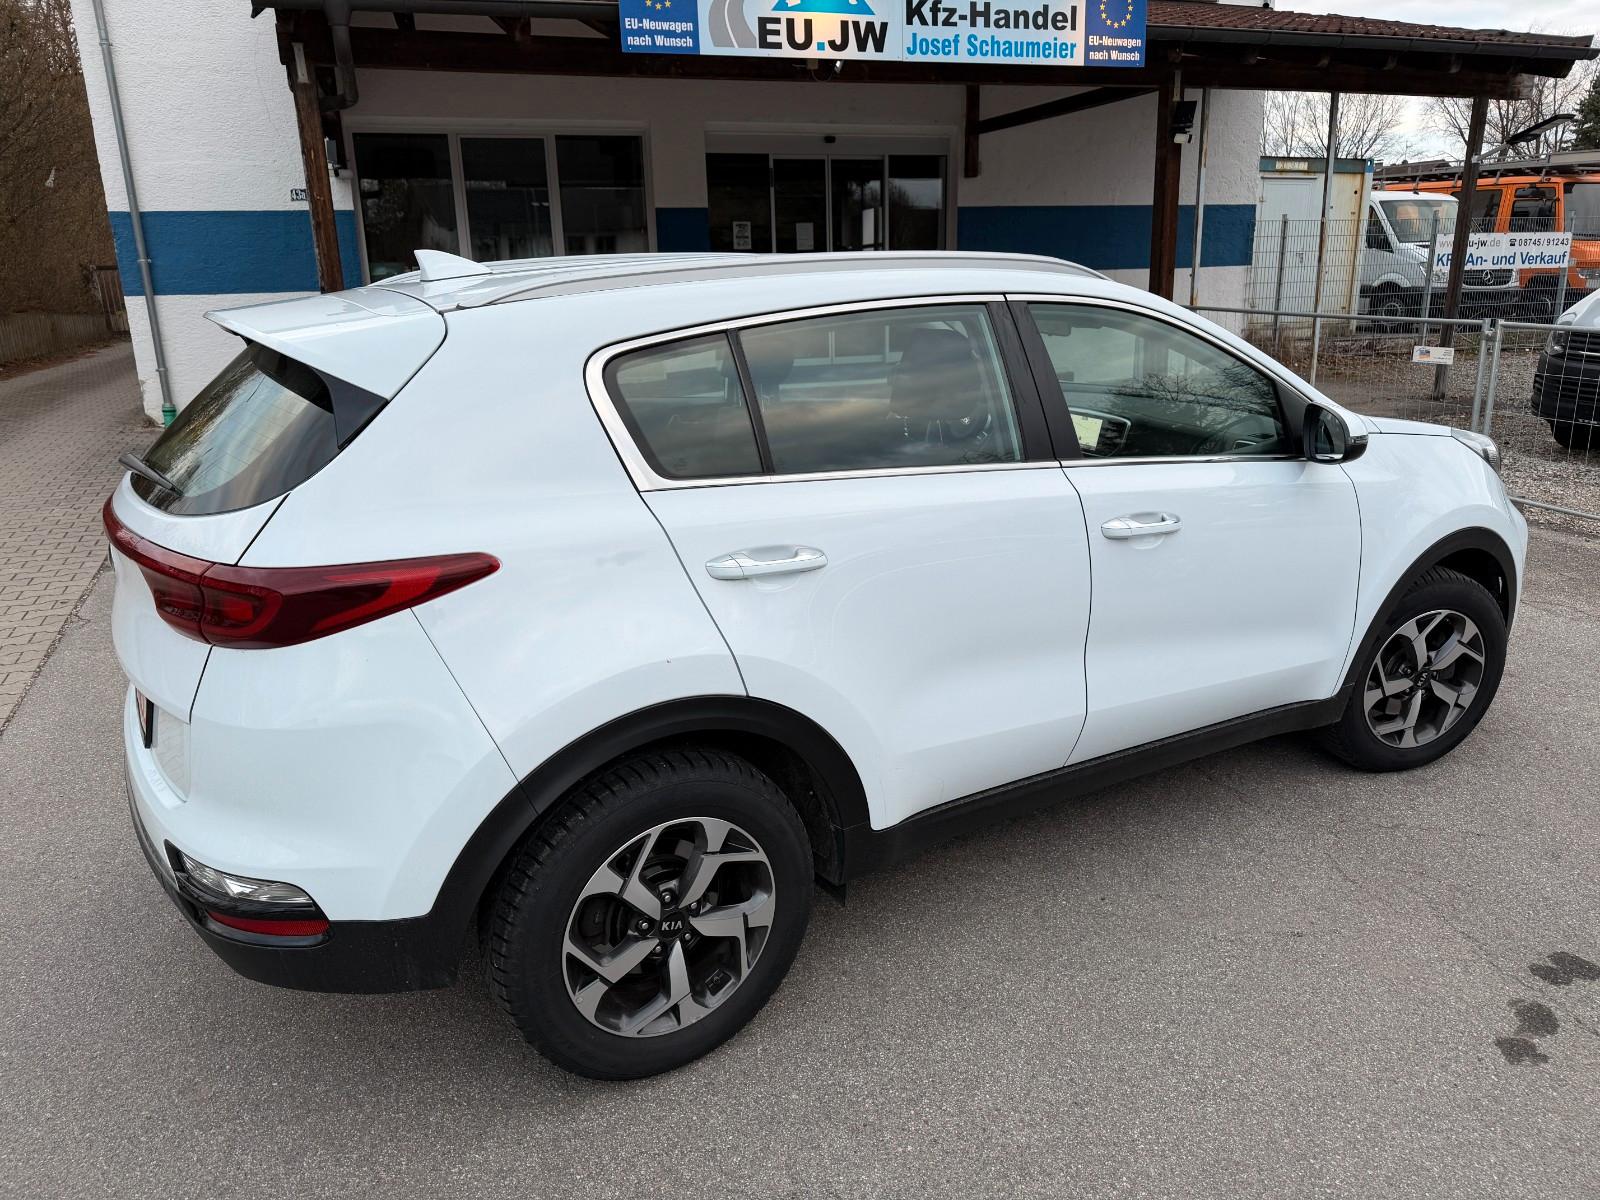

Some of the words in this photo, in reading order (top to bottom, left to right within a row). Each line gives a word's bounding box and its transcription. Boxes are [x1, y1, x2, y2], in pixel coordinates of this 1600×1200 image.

[905, 0, 1077, 31] Kfz-Handel
[624, 17, 693, 32] EU-Neuwagen
[627, 34, 651, 46] nach
[654, 35, 693, 47] Wunsch
[757, 16, 889, 53] EU.JW
[1088, 35, 1142, 49] EU-Neuwagen
[906, 32, 960, 56] Josef
[966, 33, 1077, 59] Schaumeier
[1089, 50, 1108, 60] nach
[1110, 50, 1140, 61] Wunsch
[1491, 252, 1517, 266] und
[1520, 250, 1568, 265] Verkauf
[661, 920, 683, 931] KIA
